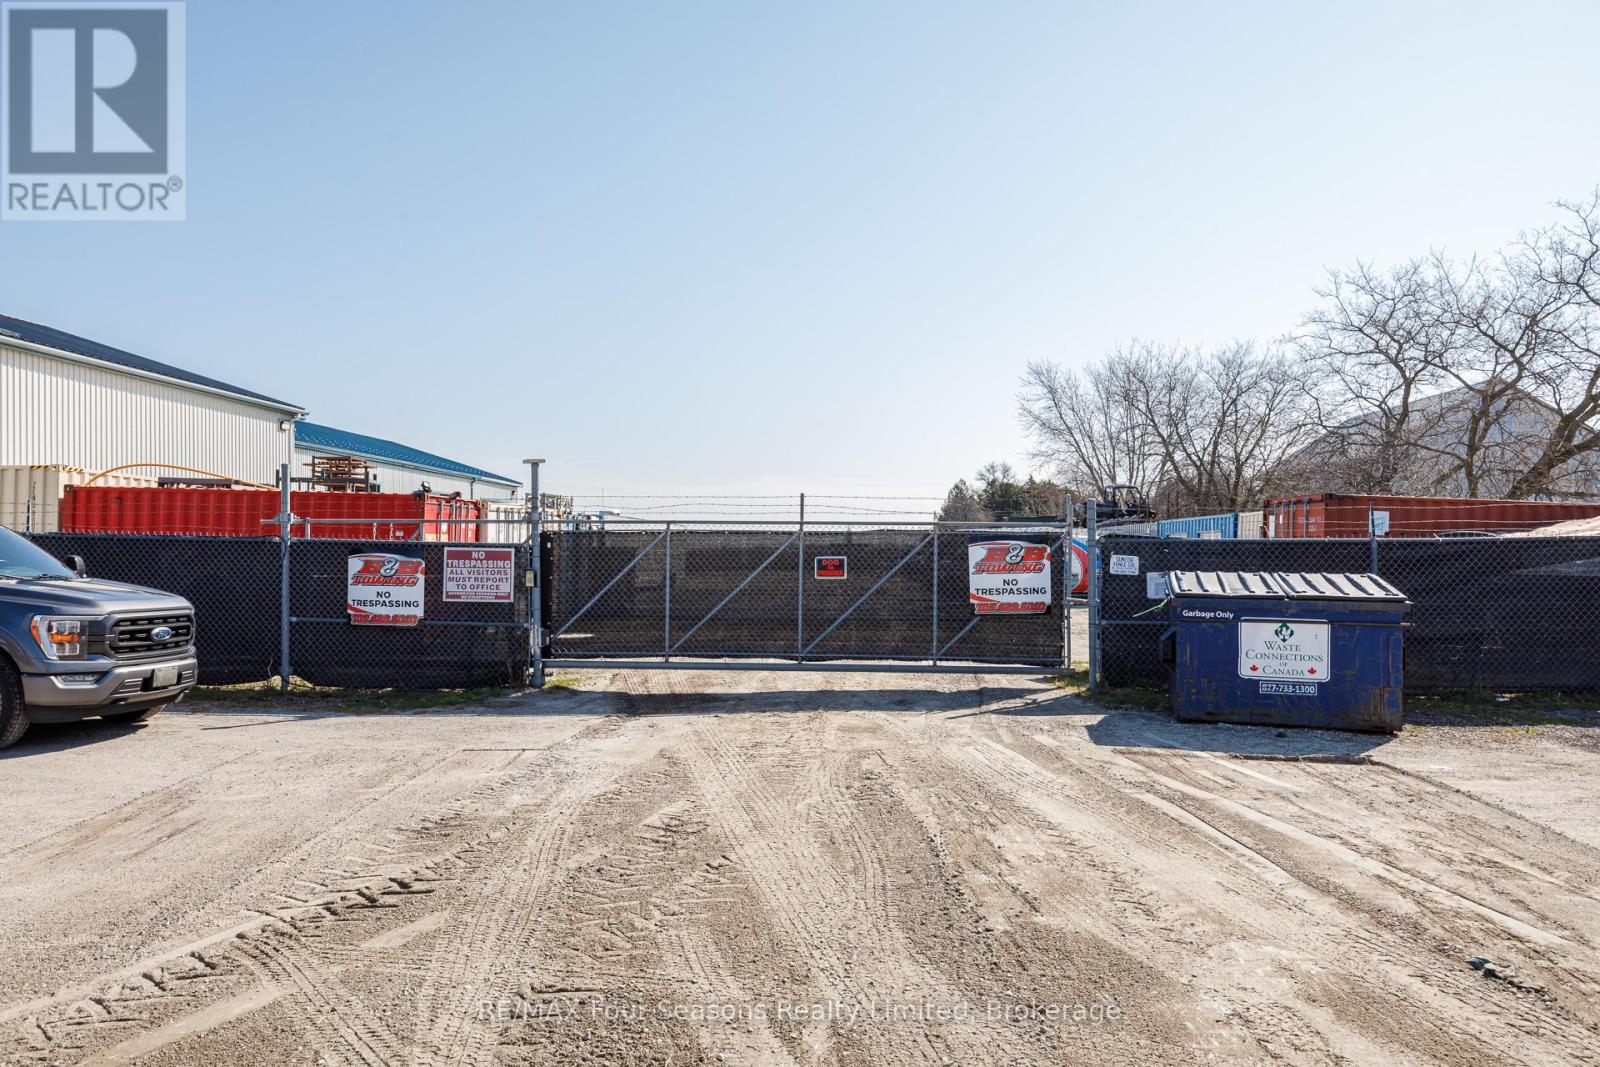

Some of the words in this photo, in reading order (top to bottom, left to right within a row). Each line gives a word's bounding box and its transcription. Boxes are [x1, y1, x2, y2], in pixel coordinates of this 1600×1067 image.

[472, 551, 486, 559] NO
[978, 543, 1047, 564] B&B
[355, 557, 420, 577] B&B
[447, 560, 511, 568] TRESPASSING
[972, 563, 1045, 574] TOWING
[350, 575, 419, 587] TOWING
[974, 587, 1047, 595] TRESPASSING
[352, 599, 419, 608] TRESPASSING
[1182, 609, 1214, 619] Garbage
[1215, 611, 1234, 620] Only
[1264, 640, 1301, 652] WASTE
[1245, 650, 1324, 662] CONNECTIONS
[1262, 665, 1305, 676] CANADA
